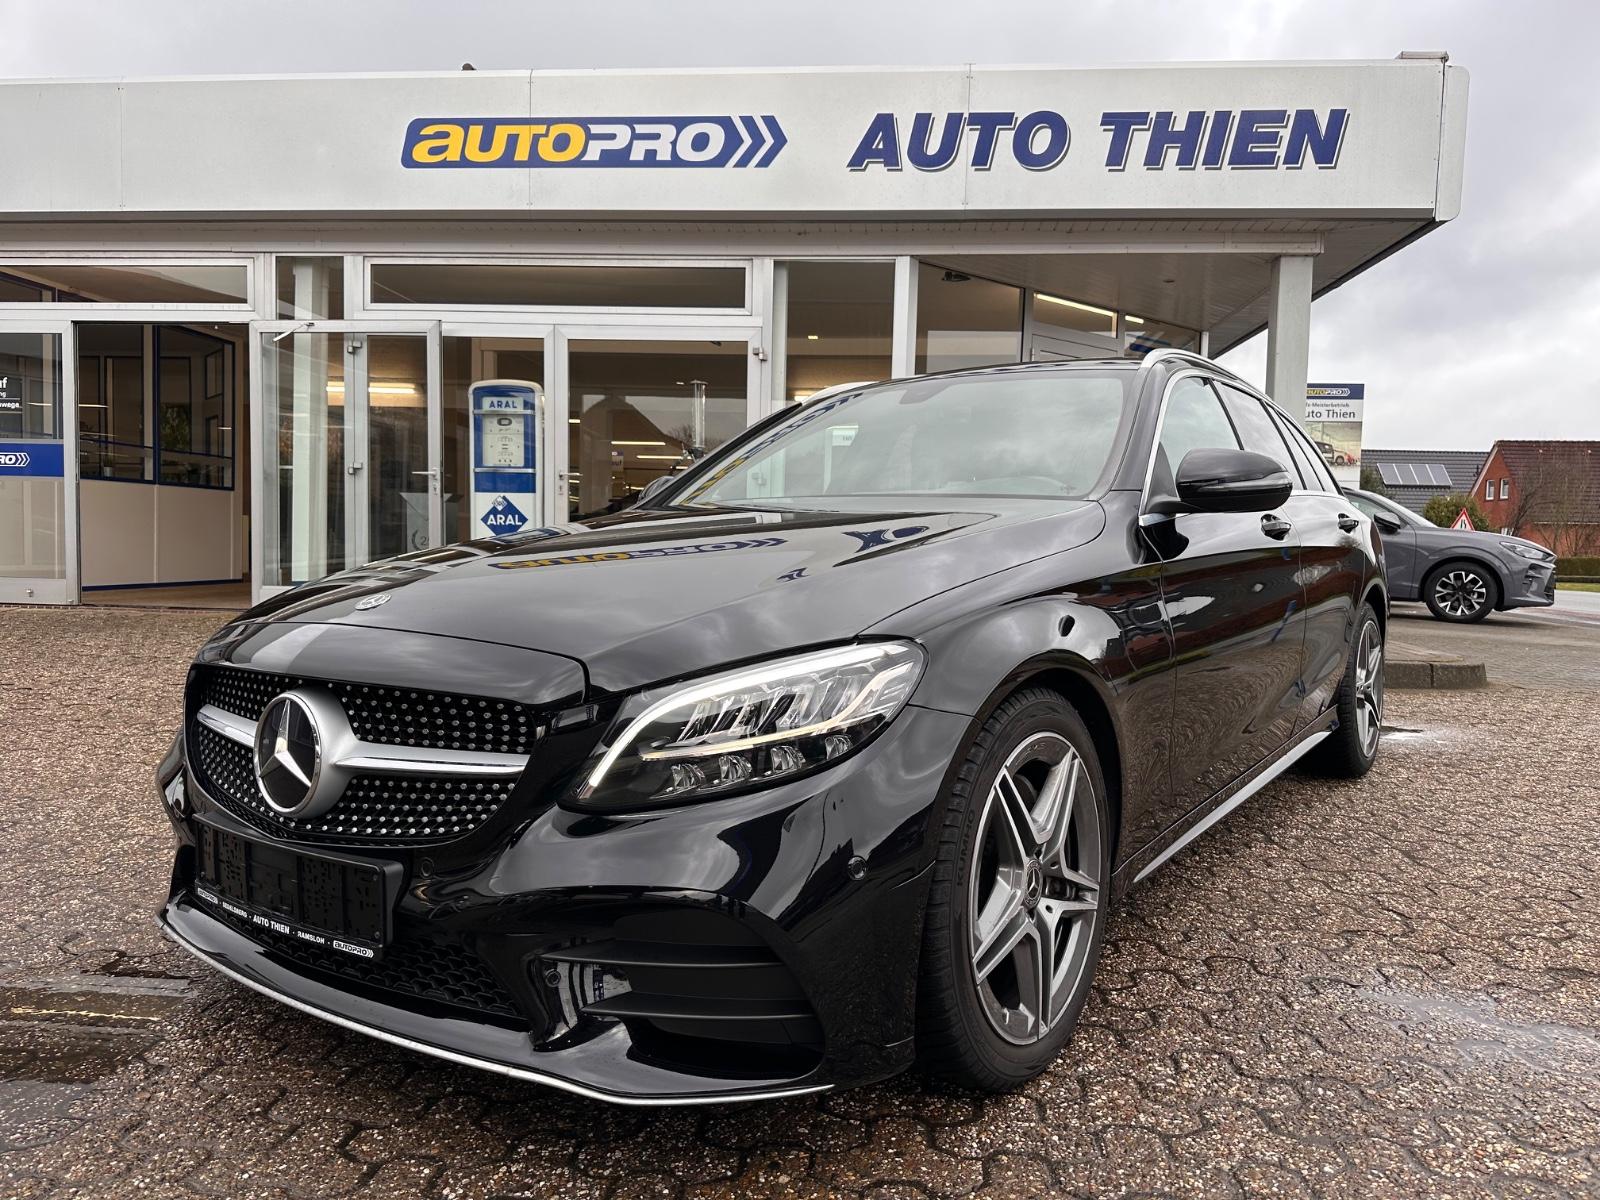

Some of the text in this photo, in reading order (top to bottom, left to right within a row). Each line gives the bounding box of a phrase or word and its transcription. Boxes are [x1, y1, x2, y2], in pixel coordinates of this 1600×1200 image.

[847, 107, 1351, 172] AUTO THIEN
[488, 400, 518, 409] ARAL
[1305, 409, 1356, 419] uto Thien
[487, 514, 523, 526] ARAL
[252, 914, 270, 928] AUTO
[270, 920, 290, 935] THIEN
[297, 931, 325, 945] RAMSLOH
